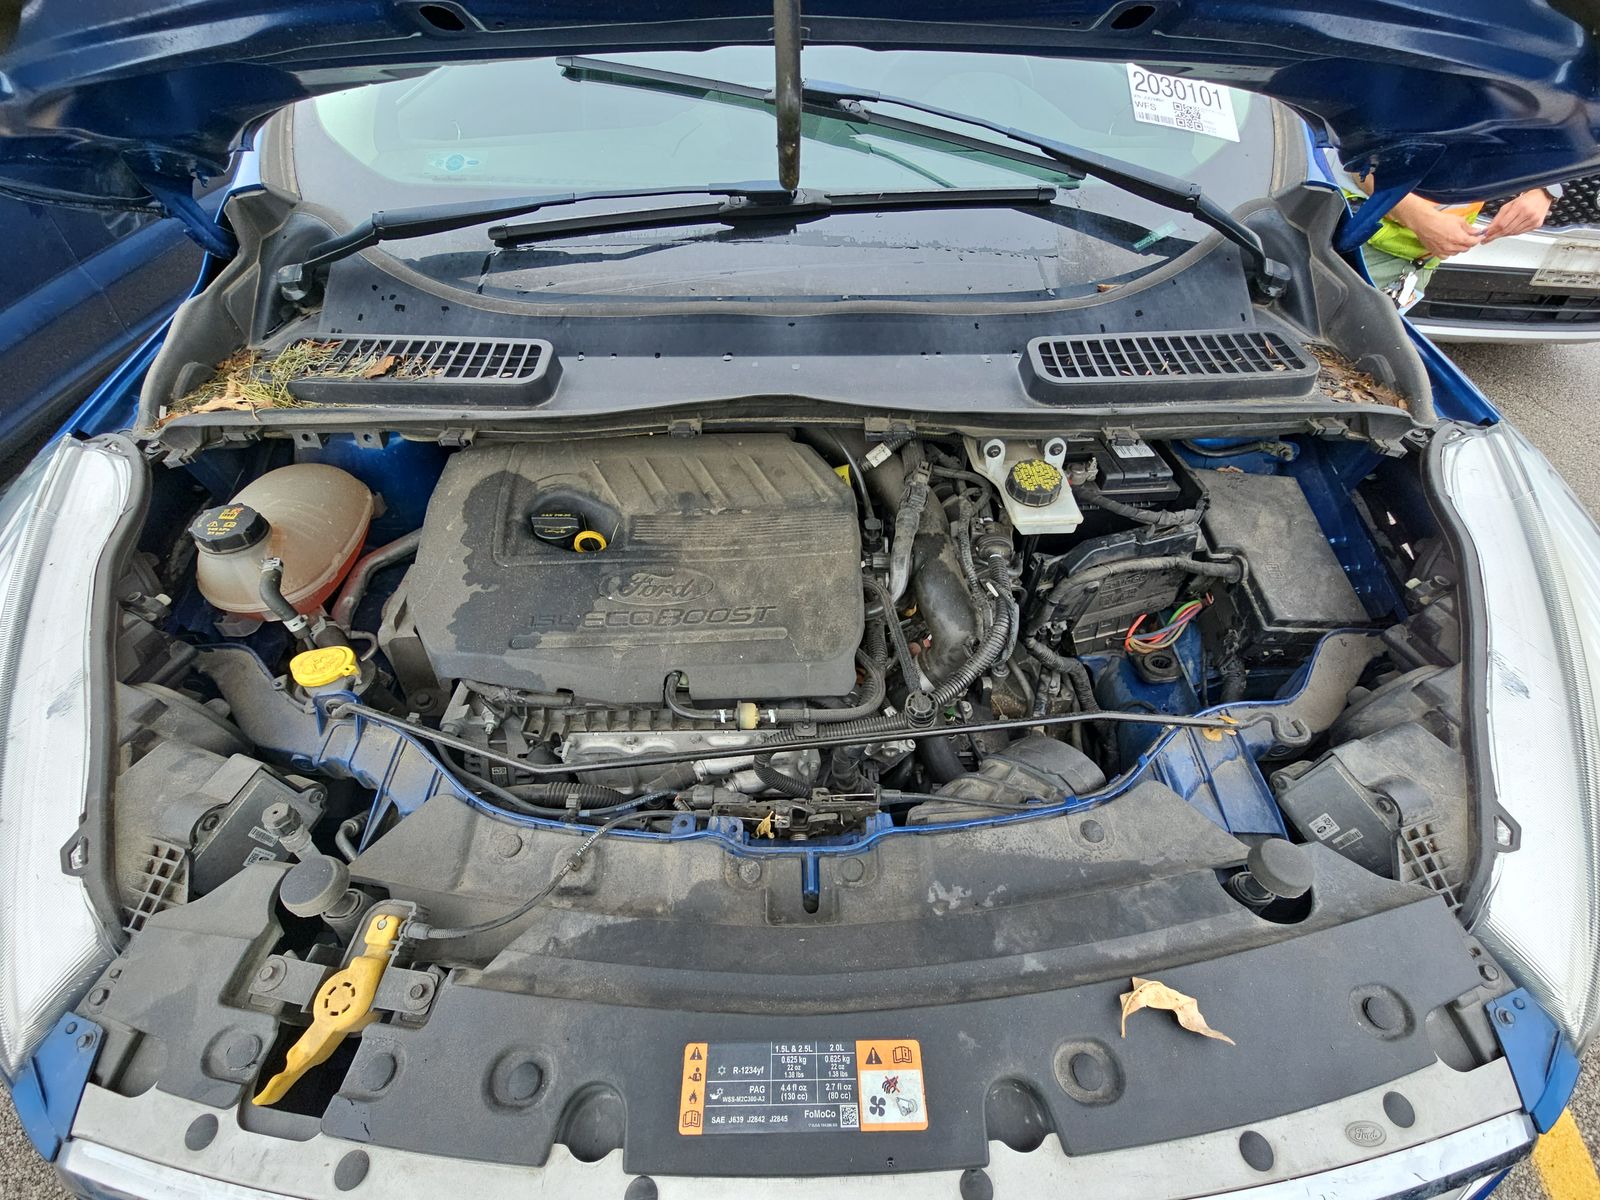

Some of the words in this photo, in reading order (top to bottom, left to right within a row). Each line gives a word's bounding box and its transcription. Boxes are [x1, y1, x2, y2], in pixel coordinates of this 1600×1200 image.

[1133, 71, 1222, 110] 2030101
[1134, 101, 1157, 112] WFS
[621, 570, 695, 598] Ford
[775, 1045, 790, 1053] 1.5L
[791, 1045, 797, 1053] &
[798, 1044, 813, 1053] 2.5L
[829, 1043, 845, 1052] 2.0L
[781, 1056, 798, 1064] 0.625
[798, 1056, 807, 1065] kg
[824, 1055, 841, 1063] 0.625
[842, 1055, 851, 1064] kg
[732, 1066, 765, 1076] R-1234yf
[749, 1085, 766, 1094] PAG
[792, 1083, 797, 1091] fl
[825, 1083, 836, 1091] 2.7
[837, 1082, 842, 1090] fl
[780, 1092, 796, 1102] (130
[797, 1092, 808, 1101] cc)
[828, 1091, 839, 1101] (80
[840, 1091, 851, 1101] cc)
[804, 1109, 837, 1119] FoMoCo
[711, 1116, 726, 1124] SAE
[728, 1116, 744, 1124] J639
[747, 1115, 766, 1123] J2842
[769, 1115, 789, 1123] J2845
[1354, 1127, 1378, 1140] Ford
